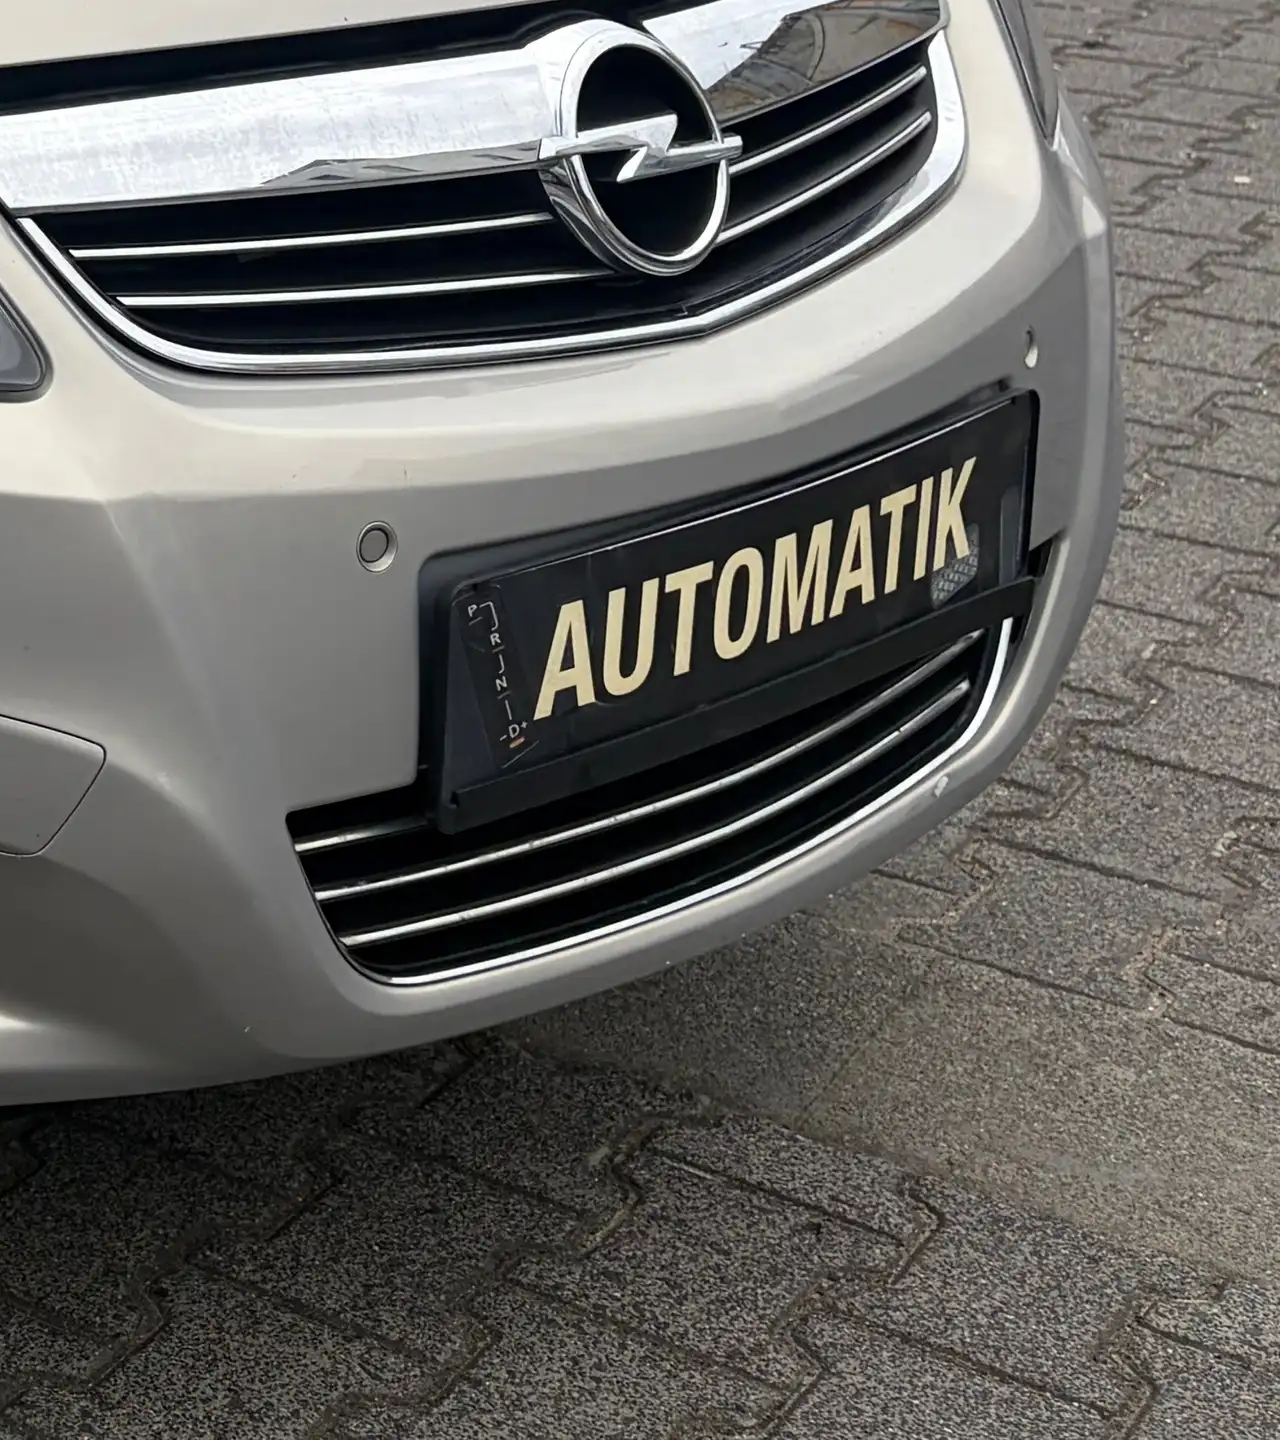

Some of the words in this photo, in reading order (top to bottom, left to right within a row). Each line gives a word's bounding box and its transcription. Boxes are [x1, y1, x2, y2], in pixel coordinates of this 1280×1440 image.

[533, 456, 977, 721] AUTOMATIK
[467, 604, 478, 617] P
[490, 632, 502, 646] R
[495, 675, 508, 692] N
